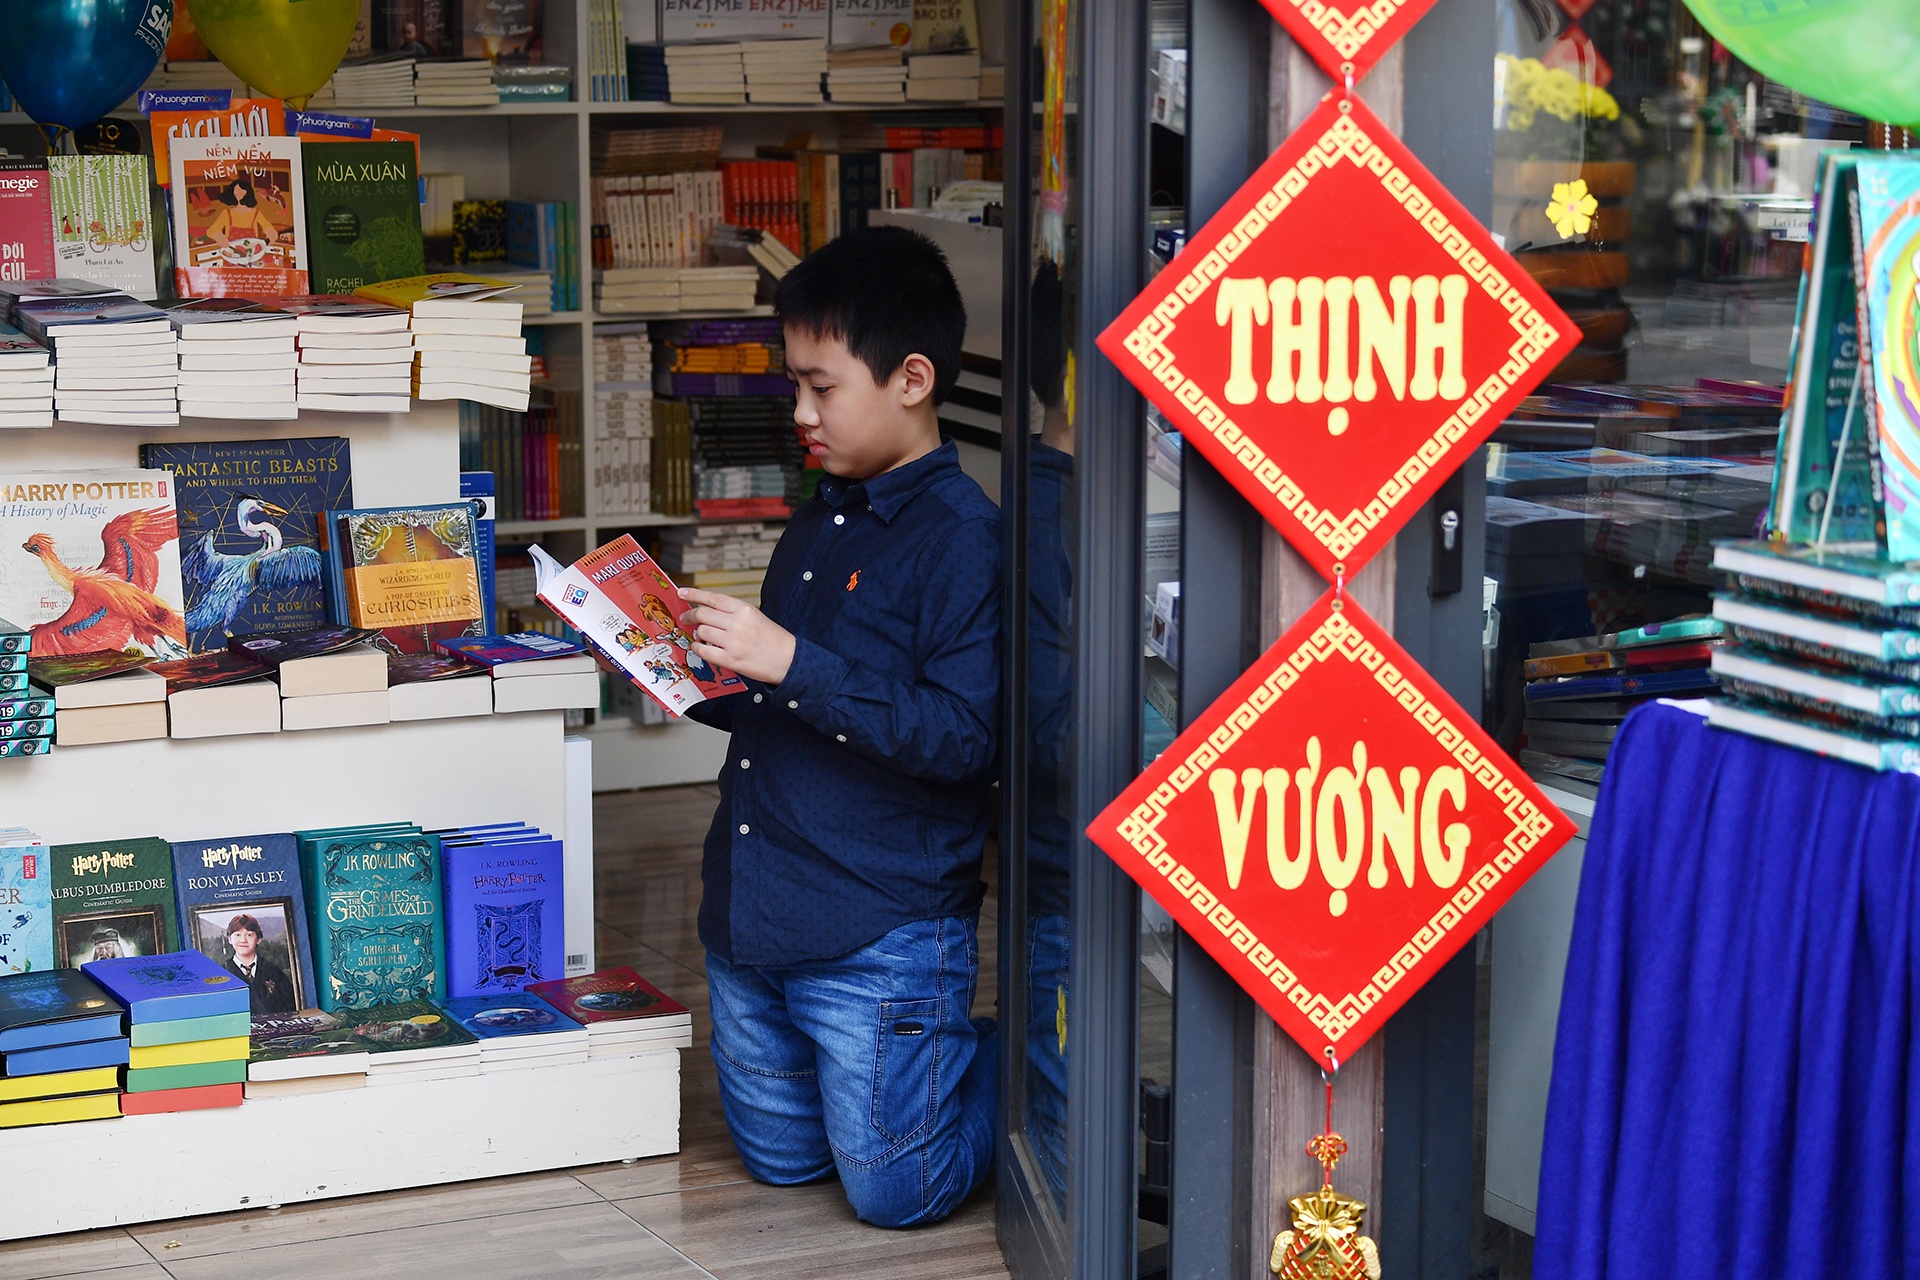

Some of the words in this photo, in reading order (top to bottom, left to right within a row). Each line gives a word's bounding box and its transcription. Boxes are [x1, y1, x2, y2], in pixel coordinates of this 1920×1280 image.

[317, 161, 357, 181] MÙA
[360, 161, 406, 181] XUÂN
[1215, 273, 1469, 436] THỊNH
[163, 460, 261, 477] FANTASTIC
[269, 457, 338, 474] BEASTS
[72, 481, 155, 500] POTTER
[186, 480, 207, 488] AND
[210, 478, 244, 487] WHERE
[249, 477, 260, 485] TO
[263, 476, 287, 485] FIND
[290, 475, 317, 484] THEM
[10, 504, 53, 520] History
[56, 503, 69, 520] of
[70, 503, 108, 519] Magic
[424, 572, 451, 581] WORLD
[591, 563, 621, 584] MARI
[616, 550, 648, 570] QUYRI
[277, 601, 322, 613] ROWLIN
[366, 595, 472, 615] CURIOSITIES
[1208, 735, 1471, 917] VƯỢNG
[71, 855, 102, 876] Harry
[100, 851, 135, 878] Potter
[201, 847, 232, 869] Harry
[229, 843, 263, 871] Potter
[362, 853, 415, 869] ROWLING
[497, 858, 538, 868] ROWLING
[50, 886, 84, 900] ALBUS
[85, 878, 167, 896] DUMBLEDORE
[188, 876, 219, 890] RON
[221, 870, 285, 887] WEASLEY
[360, 889, 409, 904] CRIMES
[327, 898, 435, 922] GRINDELWALD
[363, 944, 401, 954] ORIGINAL
[358, 954, 408, 966] SCREENPLAY
